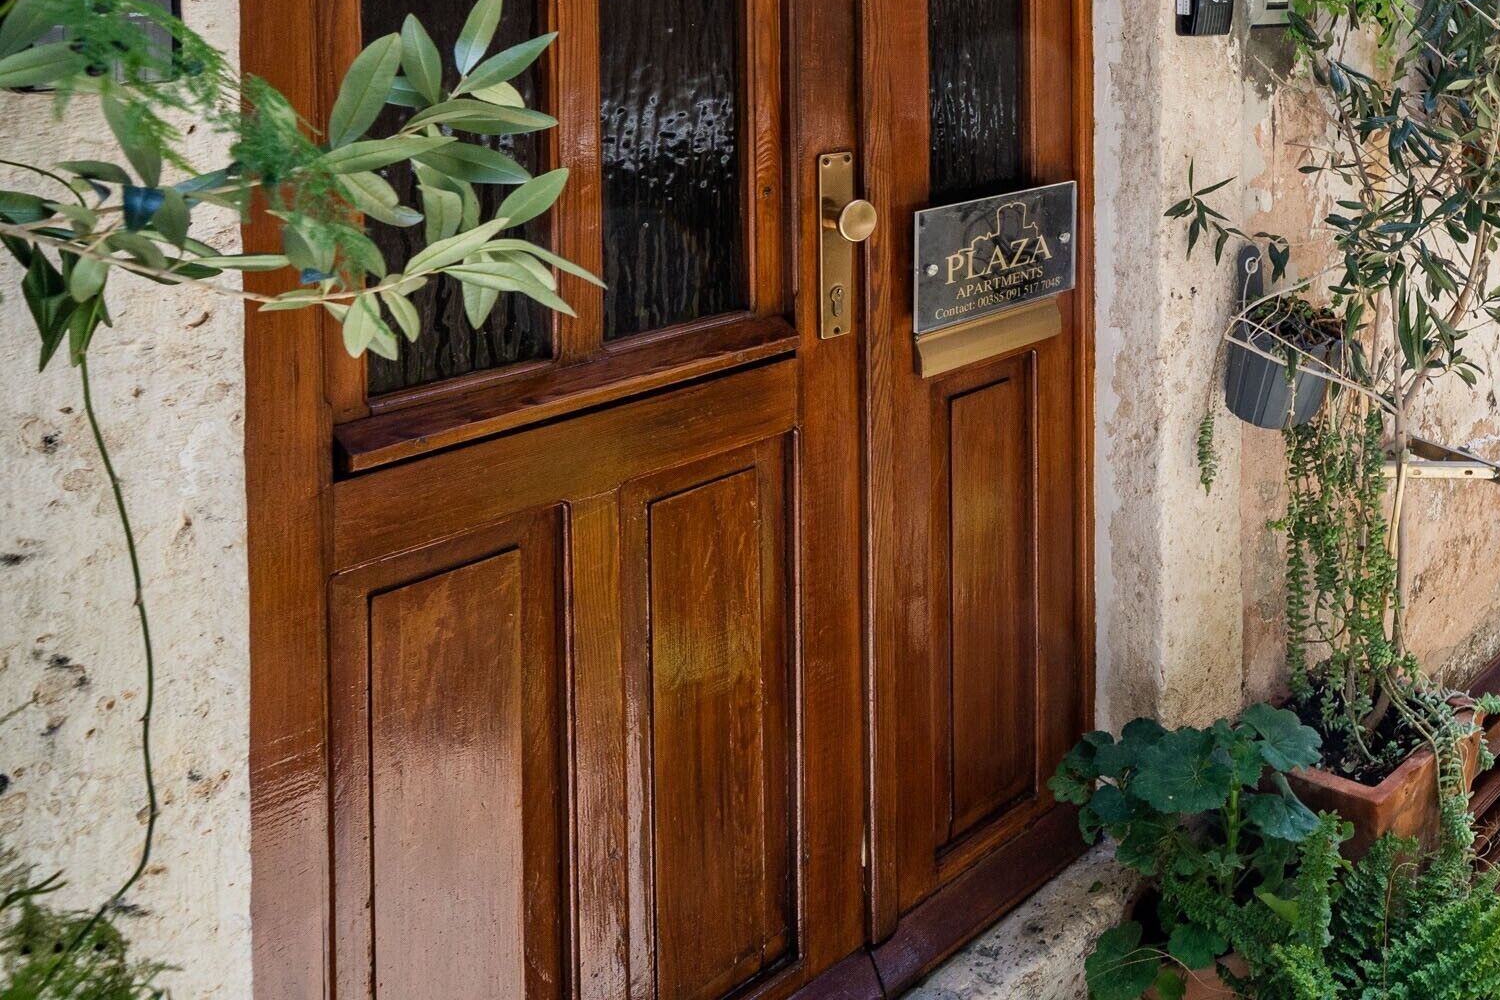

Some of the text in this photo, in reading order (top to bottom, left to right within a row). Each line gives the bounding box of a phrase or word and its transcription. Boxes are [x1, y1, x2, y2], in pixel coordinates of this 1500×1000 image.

[944, 234, 1053, 285] PLAZA
[935, 301, 976, 320] Contact:
[977, 293, 1004, 308] 00385
[1006, 287, 1021, 301] 091
[1023, 282, 1039, 296] 517
[956, 265, 1044, 300] APARTMENTS
